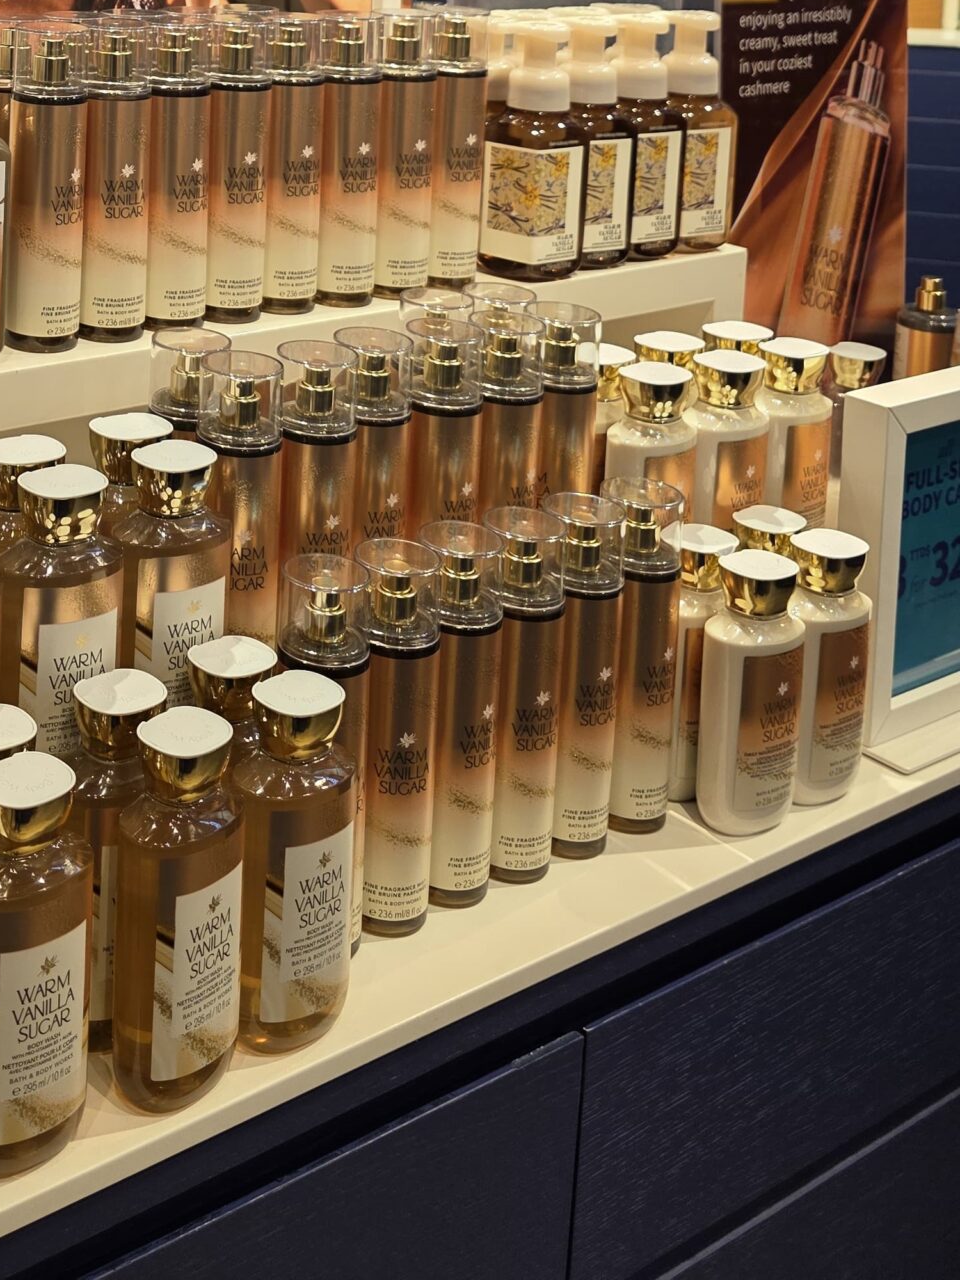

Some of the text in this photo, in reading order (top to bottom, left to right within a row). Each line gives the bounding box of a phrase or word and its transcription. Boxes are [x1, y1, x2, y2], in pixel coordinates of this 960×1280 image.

[739, 5, 852, 30] enjoying an irresistibly
[739, 29, 838, 53] creamy, sweet treat
[739, 53, 813, 74] in your coziest
[739, 80, 791, 98] cashmere
[227, 167, 264, 180] WARM
[104, 179, 143, 193] WARM
[100, 192, 145, 205] VANILLA
[227, 192, 264, 204] SUGAR
[105, 205, 143, 219] SUGAR
[167, 615, 212, 638] WARM
[53, 648, 103, 672] WARM
[762, 723, 795, 743] SUGAR
[378, 748, 427, 765] WARM
[374, 762, 429, 778] VANILLA
[379, 778, 427, 796] SUGAR
[299, 864, 342, 895] WARM
[294, 882, 345, 913] VANILLA
[299, 898, 342, 928] SUGAR
[378, 909, 393, 919] 236
[189, 906, 231, 944] WARM
[185, 924, 233, 962] VANILLA
[190, 942, 230, 980] SUGAR
[17, 970, 71, 1005] WARM
[12, 987, 75, 1025] VANILLA
[18, 1007, 71, 1044] SUGAR
[27, 1032, 61, 1050] BODY WASH
[9, 1075, 27, 1085] BATH
[36, 1064, 53, 1076] BODY
[23, 1081, 38, 1095] 295
